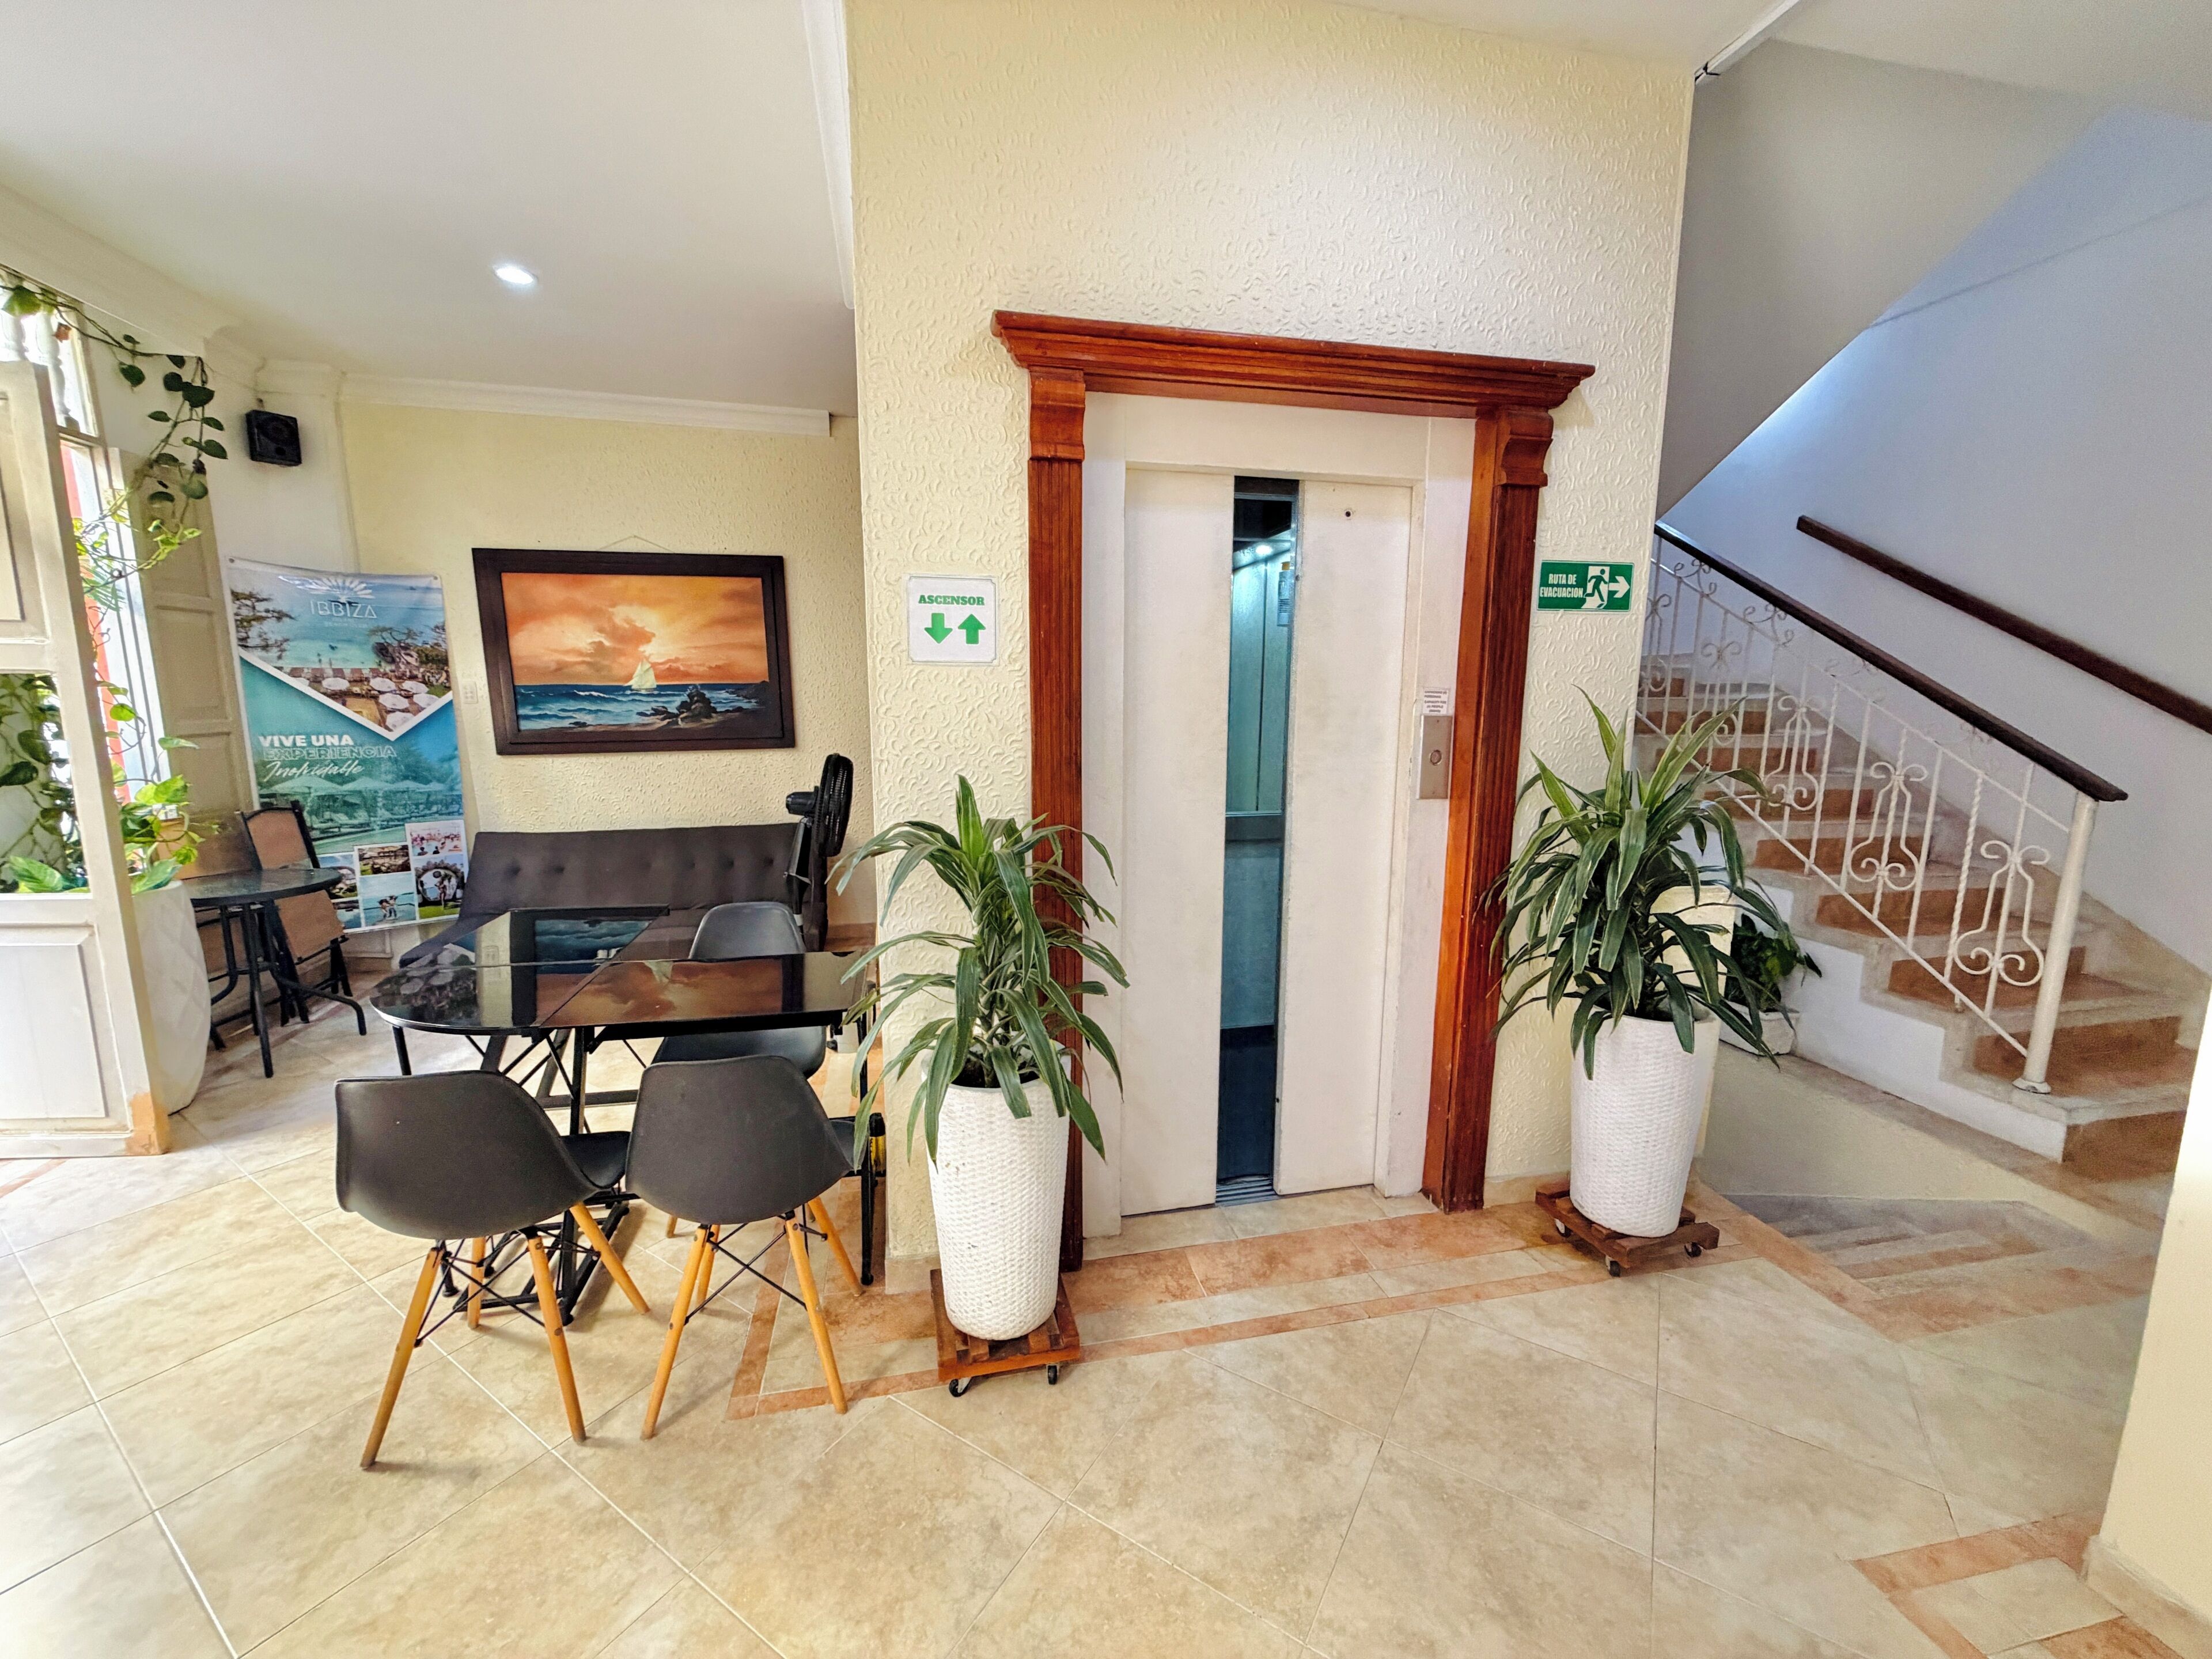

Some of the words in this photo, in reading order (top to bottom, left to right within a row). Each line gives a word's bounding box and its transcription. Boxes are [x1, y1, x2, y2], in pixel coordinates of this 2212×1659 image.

[1548, 574, 1566, 585] RUTA
[1568, 574, 1577, 585] DE
[1540, 587, 1583, 598] EVACUACION
[918, 594, 985, 605] ASCENSOR
[310, 600, 377, 618] IBBIZA
[259, 735, 307, 747] VIVE
[311, 734, 354, 746] UNA
[263, 745, 397, 761] EXPERIENCIA
